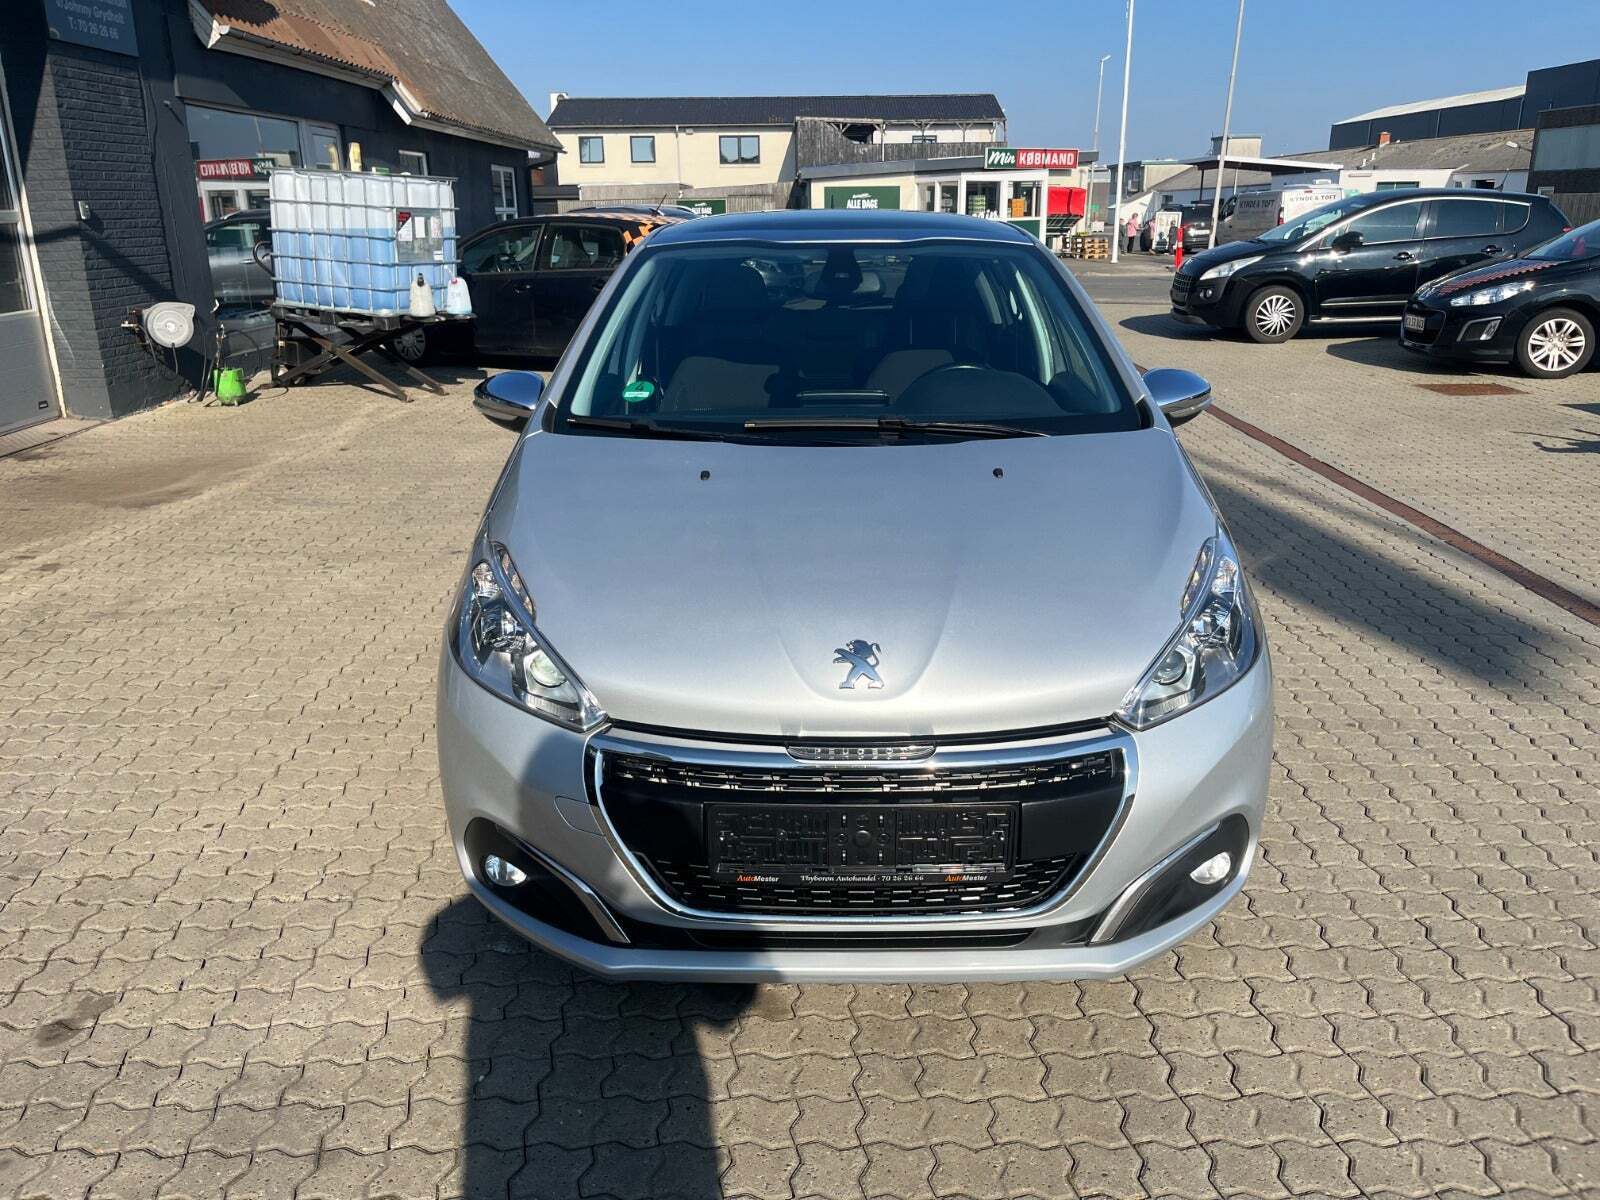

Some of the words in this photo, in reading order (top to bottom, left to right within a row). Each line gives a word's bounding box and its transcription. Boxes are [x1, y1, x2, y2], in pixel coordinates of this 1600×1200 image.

[988, 150, 1016, 165] Min
[1018, 151, 1075, 165] KØBMAND
[846, 199, 861, 209] ALLE
[862, 199, 879, 209] DAGE
[1261, 199, 1275, 209] TOFT
[835, 874, 876, 882] Autohandel
[944, 874, 987, 882] AutoMester
